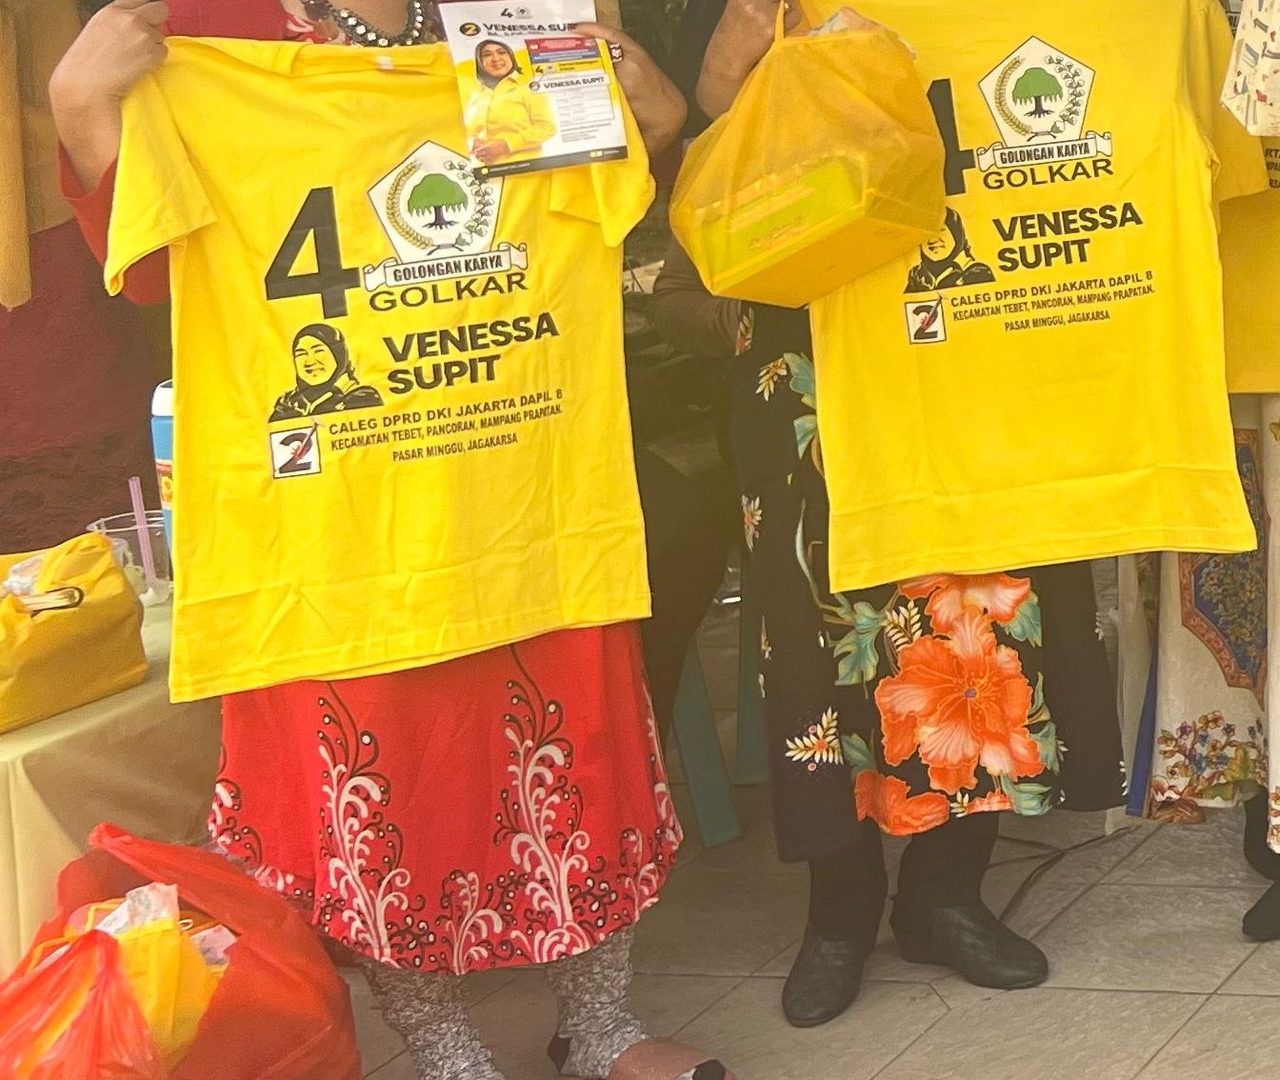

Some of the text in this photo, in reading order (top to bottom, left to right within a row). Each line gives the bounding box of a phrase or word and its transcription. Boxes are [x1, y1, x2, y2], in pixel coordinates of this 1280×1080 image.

[465, 24, 476, 36] 2
[483, 23, 546, 32] VENESSA
[544, 80, 580, 89] VENESSA
[1000, 141, 1090, 165] GOLONGAN KARYA
[983, 158, 1115, 190] GOLKAR
[992, 202, 1143, 242] VENESSA
[265, 187, 361, 319] 4
[393, 255, 503, 282] GOLONGAN KARYA
[997, 238, 1091, 272] SUPIT
[369, 273, 528, 312] GOLKAR
[951, 270, 1153, 307] CALEG DPRD DKI JAKARTA DAPIL 8
[953, 284, 1155, 322] KECAMATAN TEBET, PANCORAN, MAMPANG PRAPATAN.
[383, 312, 559, 363] VENESSA
[913, 304, 939, 340] 2
[1005, 310, 1111, 332] PASAR MINGGU, JAGAKARSA
[387, 355, 501, 395] SUPIT
[329, 389, 563, 435] CALEG DPRD DKI JAKARTA DAPIL 8
[331, 412, 521, 451] KECAMATAN TEBET, PANCORAN, MAMPANG
[393, 433, 518, 462] PASAR MINGGU, JAGAKARSA
[279, 432, 313, 474] 2
